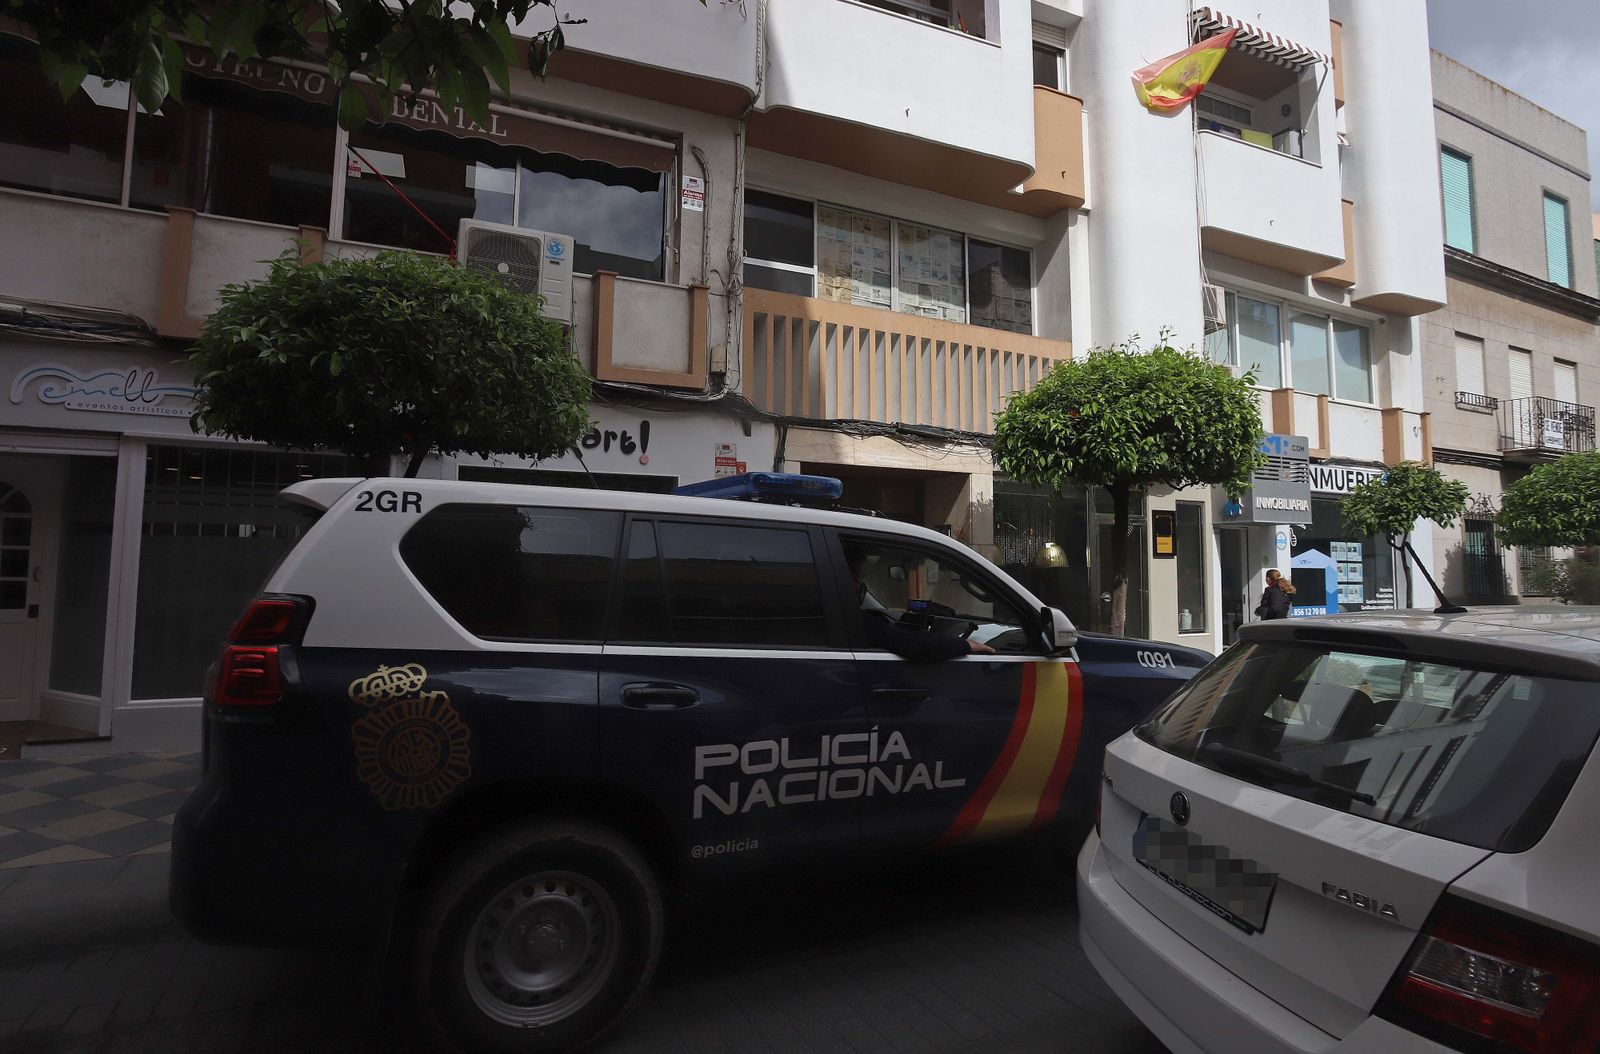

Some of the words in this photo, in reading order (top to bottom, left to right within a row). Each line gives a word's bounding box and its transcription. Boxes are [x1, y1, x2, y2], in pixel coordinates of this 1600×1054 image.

[77, 402, 125, 411] eventos
[354, 490, 423, 514] 2GR
[1255, 496, 1309, 512] INMOBILIARIA
[1293, 608, 1305, 616] 856
[1305, 608, 1312, 616] 12
[694, 724, 912, 780] POLICÍA
[692, 760, 966, 819] NACIONAL
[690, 838, 760, 859] @policia
[1321, 880, 1399, 921] FABIA
